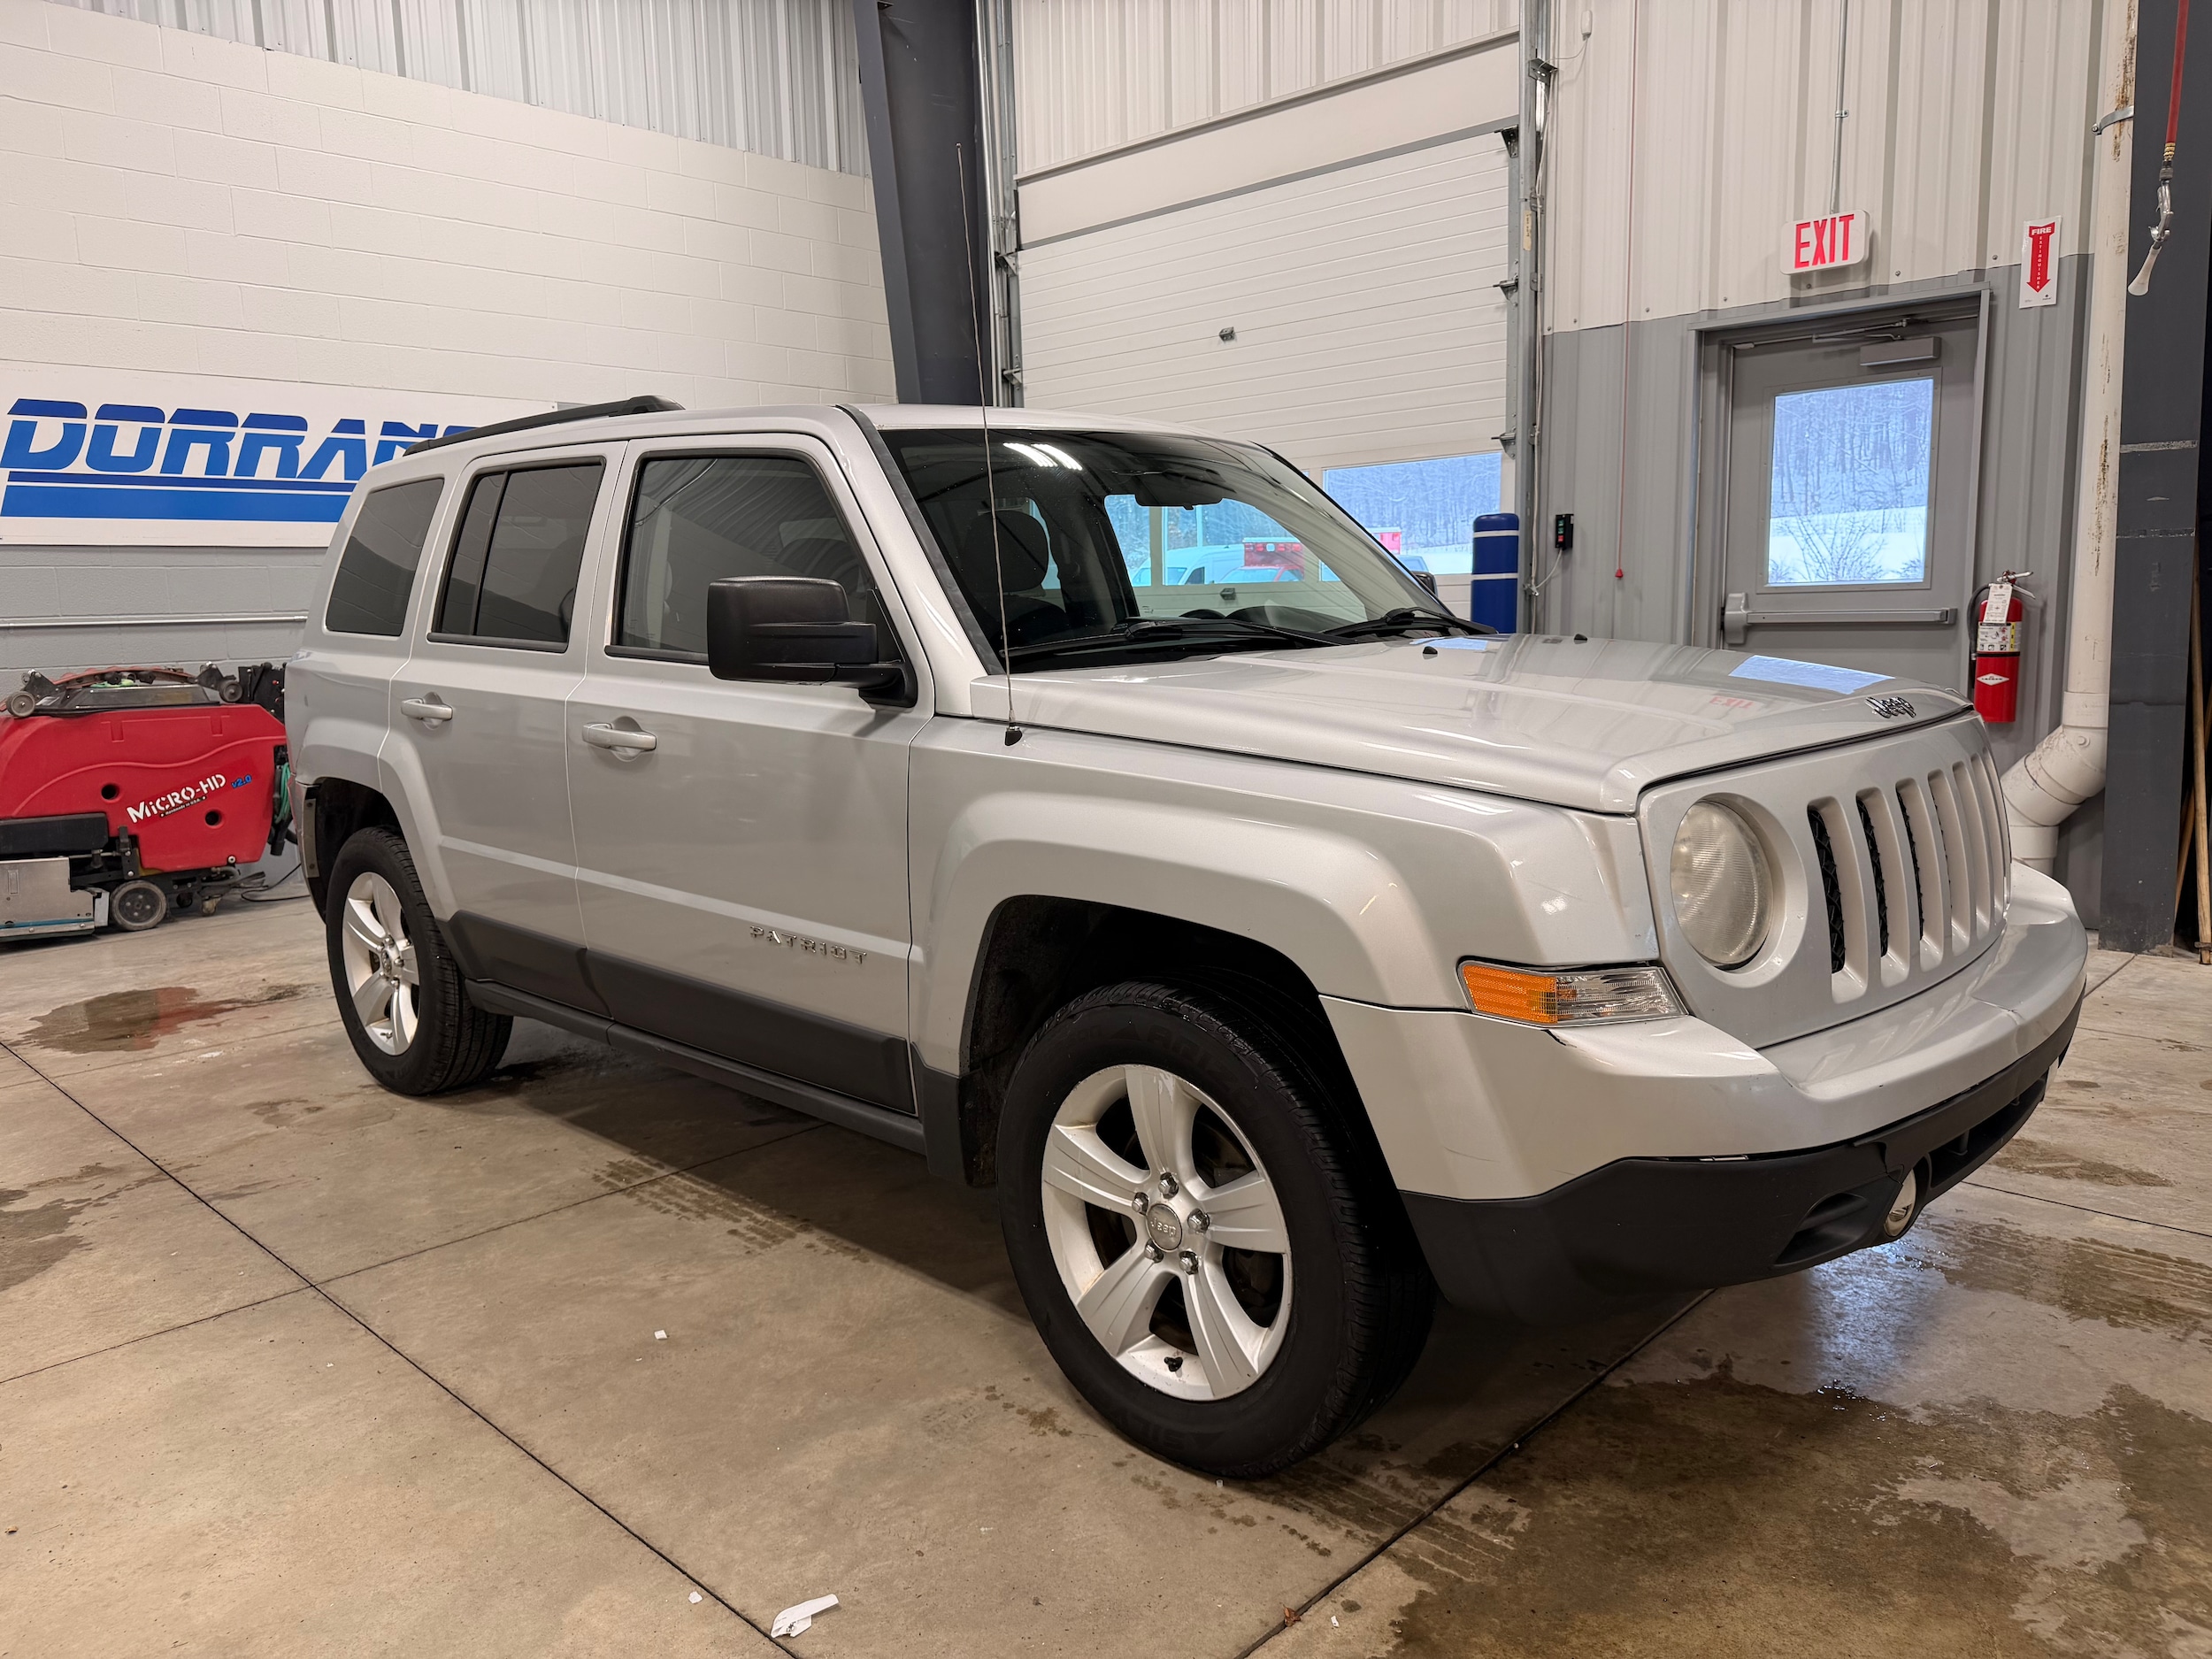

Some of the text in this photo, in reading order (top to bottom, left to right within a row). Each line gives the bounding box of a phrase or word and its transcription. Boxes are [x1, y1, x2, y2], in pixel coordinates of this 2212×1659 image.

[1794, 213, 1855, 269] EXIT
[2031, 227, 2052, 236] FIRE
[0, 398, 479, 481] DORRAN
[1865, 696, 1916, 718] Jeep
[231, 774, 253, 788] v2.0
[750, 926, 867, 964] PATRIOT
[1150, 1217, 1176, 1237] Jeep
